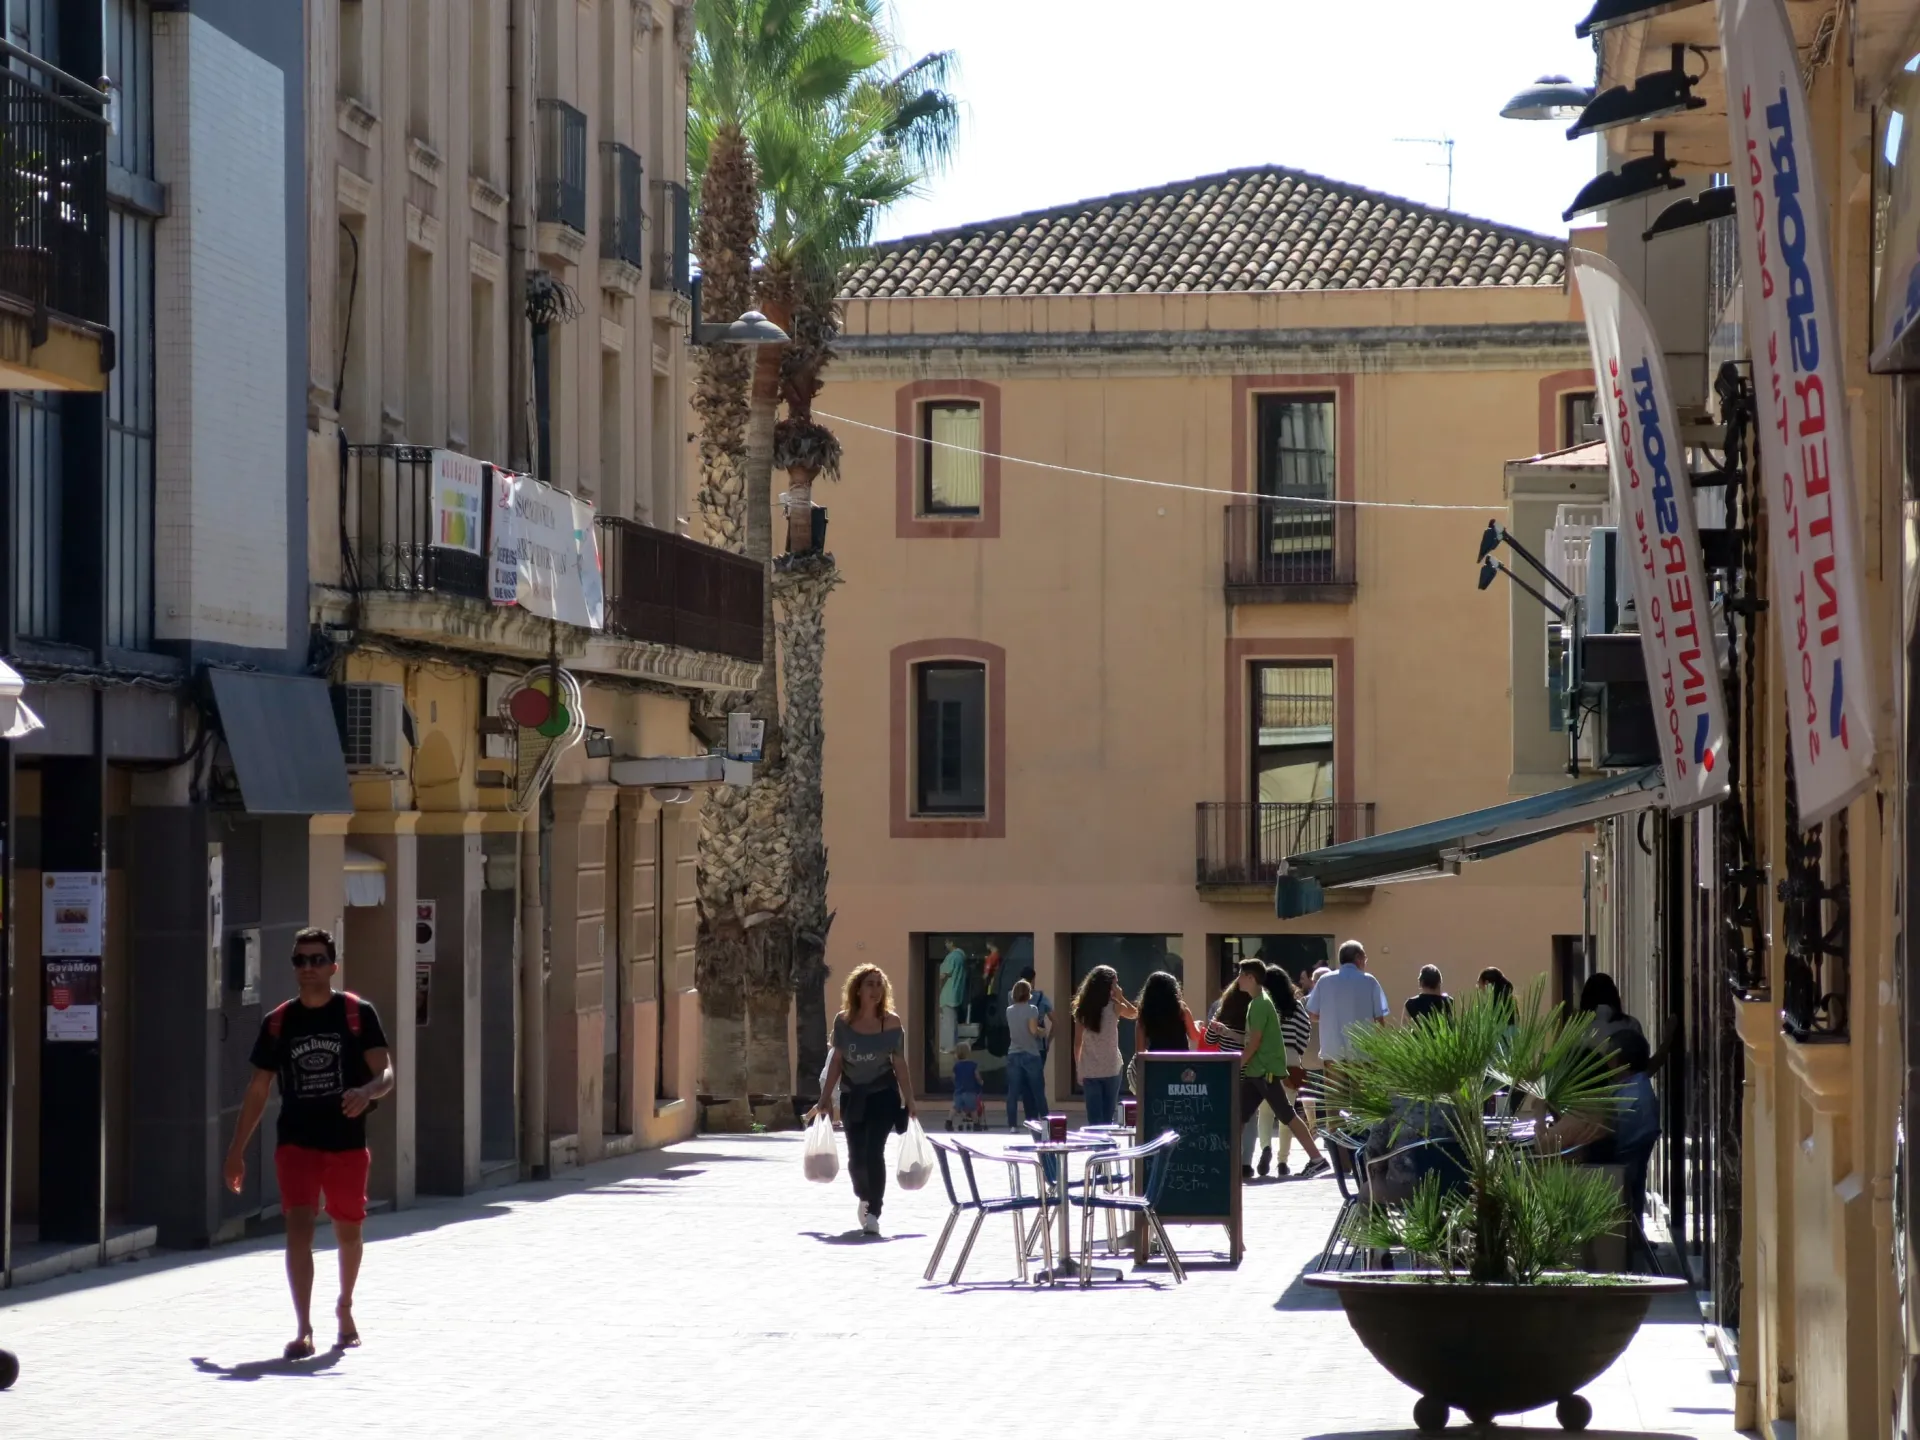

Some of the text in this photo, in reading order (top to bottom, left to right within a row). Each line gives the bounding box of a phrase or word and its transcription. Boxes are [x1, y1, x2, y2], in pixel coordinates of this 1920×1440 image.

[46, 961, 97, 973] GavàMón
[291, 1042, 310, 1059] JACK
[847, 1043, 877, 1062] Love
[1168, 1083, 1208, 1096] BRASILIA
[1152, 1096, 1213, 1116] OFERTA
